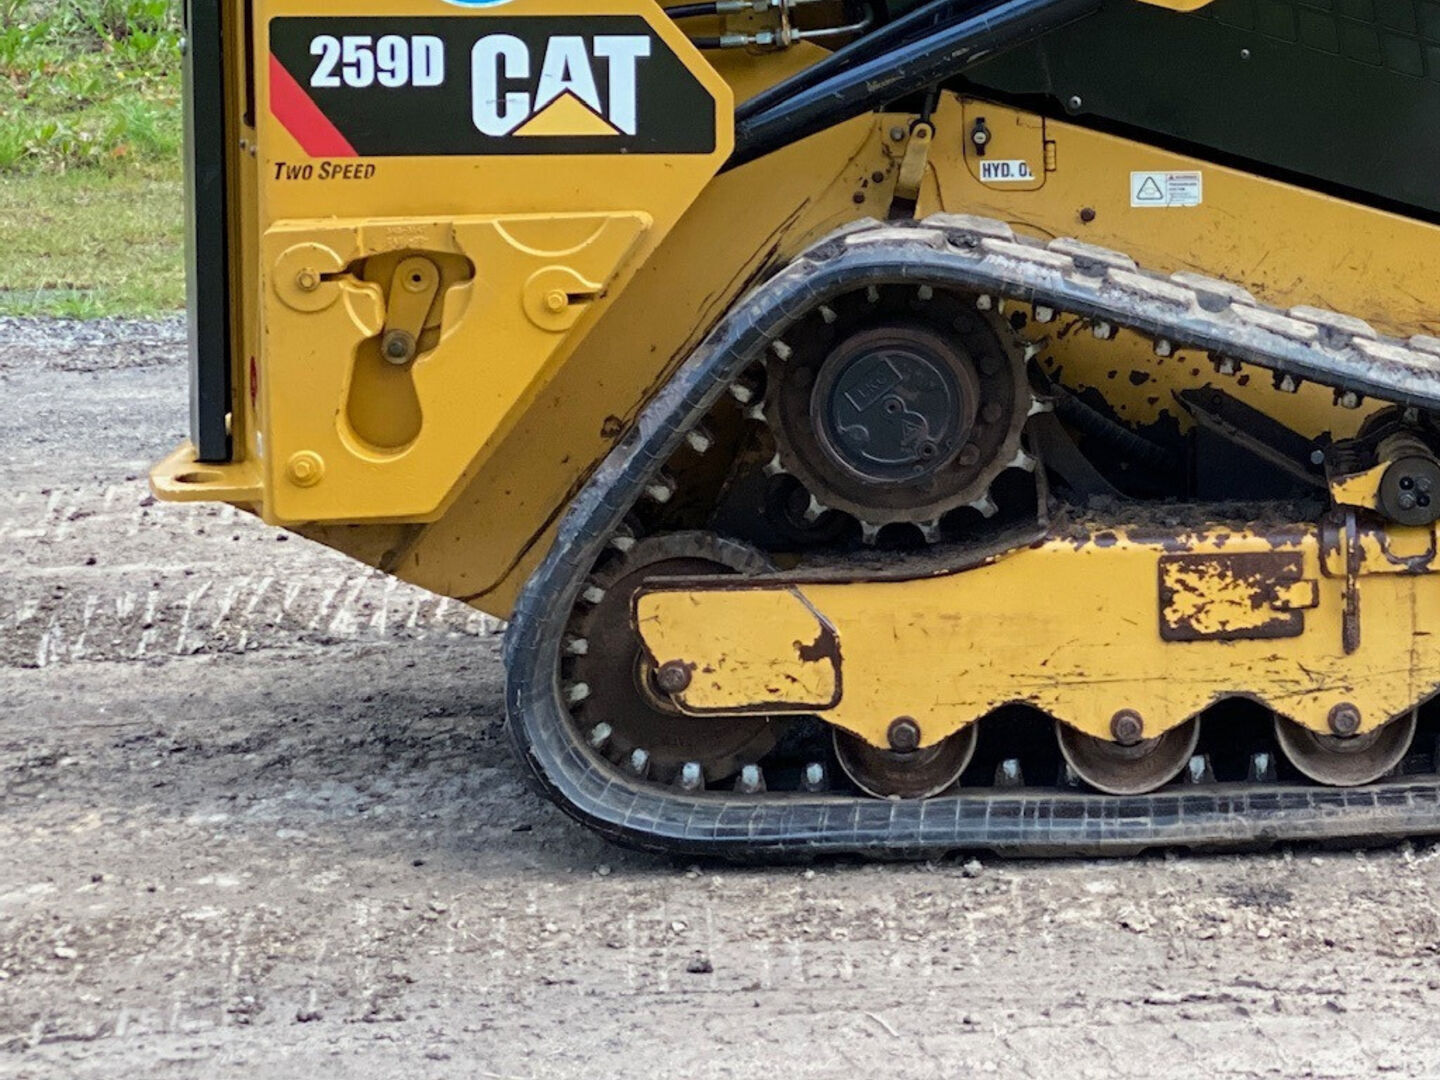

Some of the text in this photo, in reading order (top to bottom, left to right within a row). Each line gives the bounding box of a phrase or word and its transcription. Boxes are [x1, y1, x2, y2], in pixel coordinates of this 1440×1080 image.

[309, 34, 651, 137] 259D CAT
[274, 160, 377, 181] TWO SPEED
[982, 162, 1015, 178] HYD.
